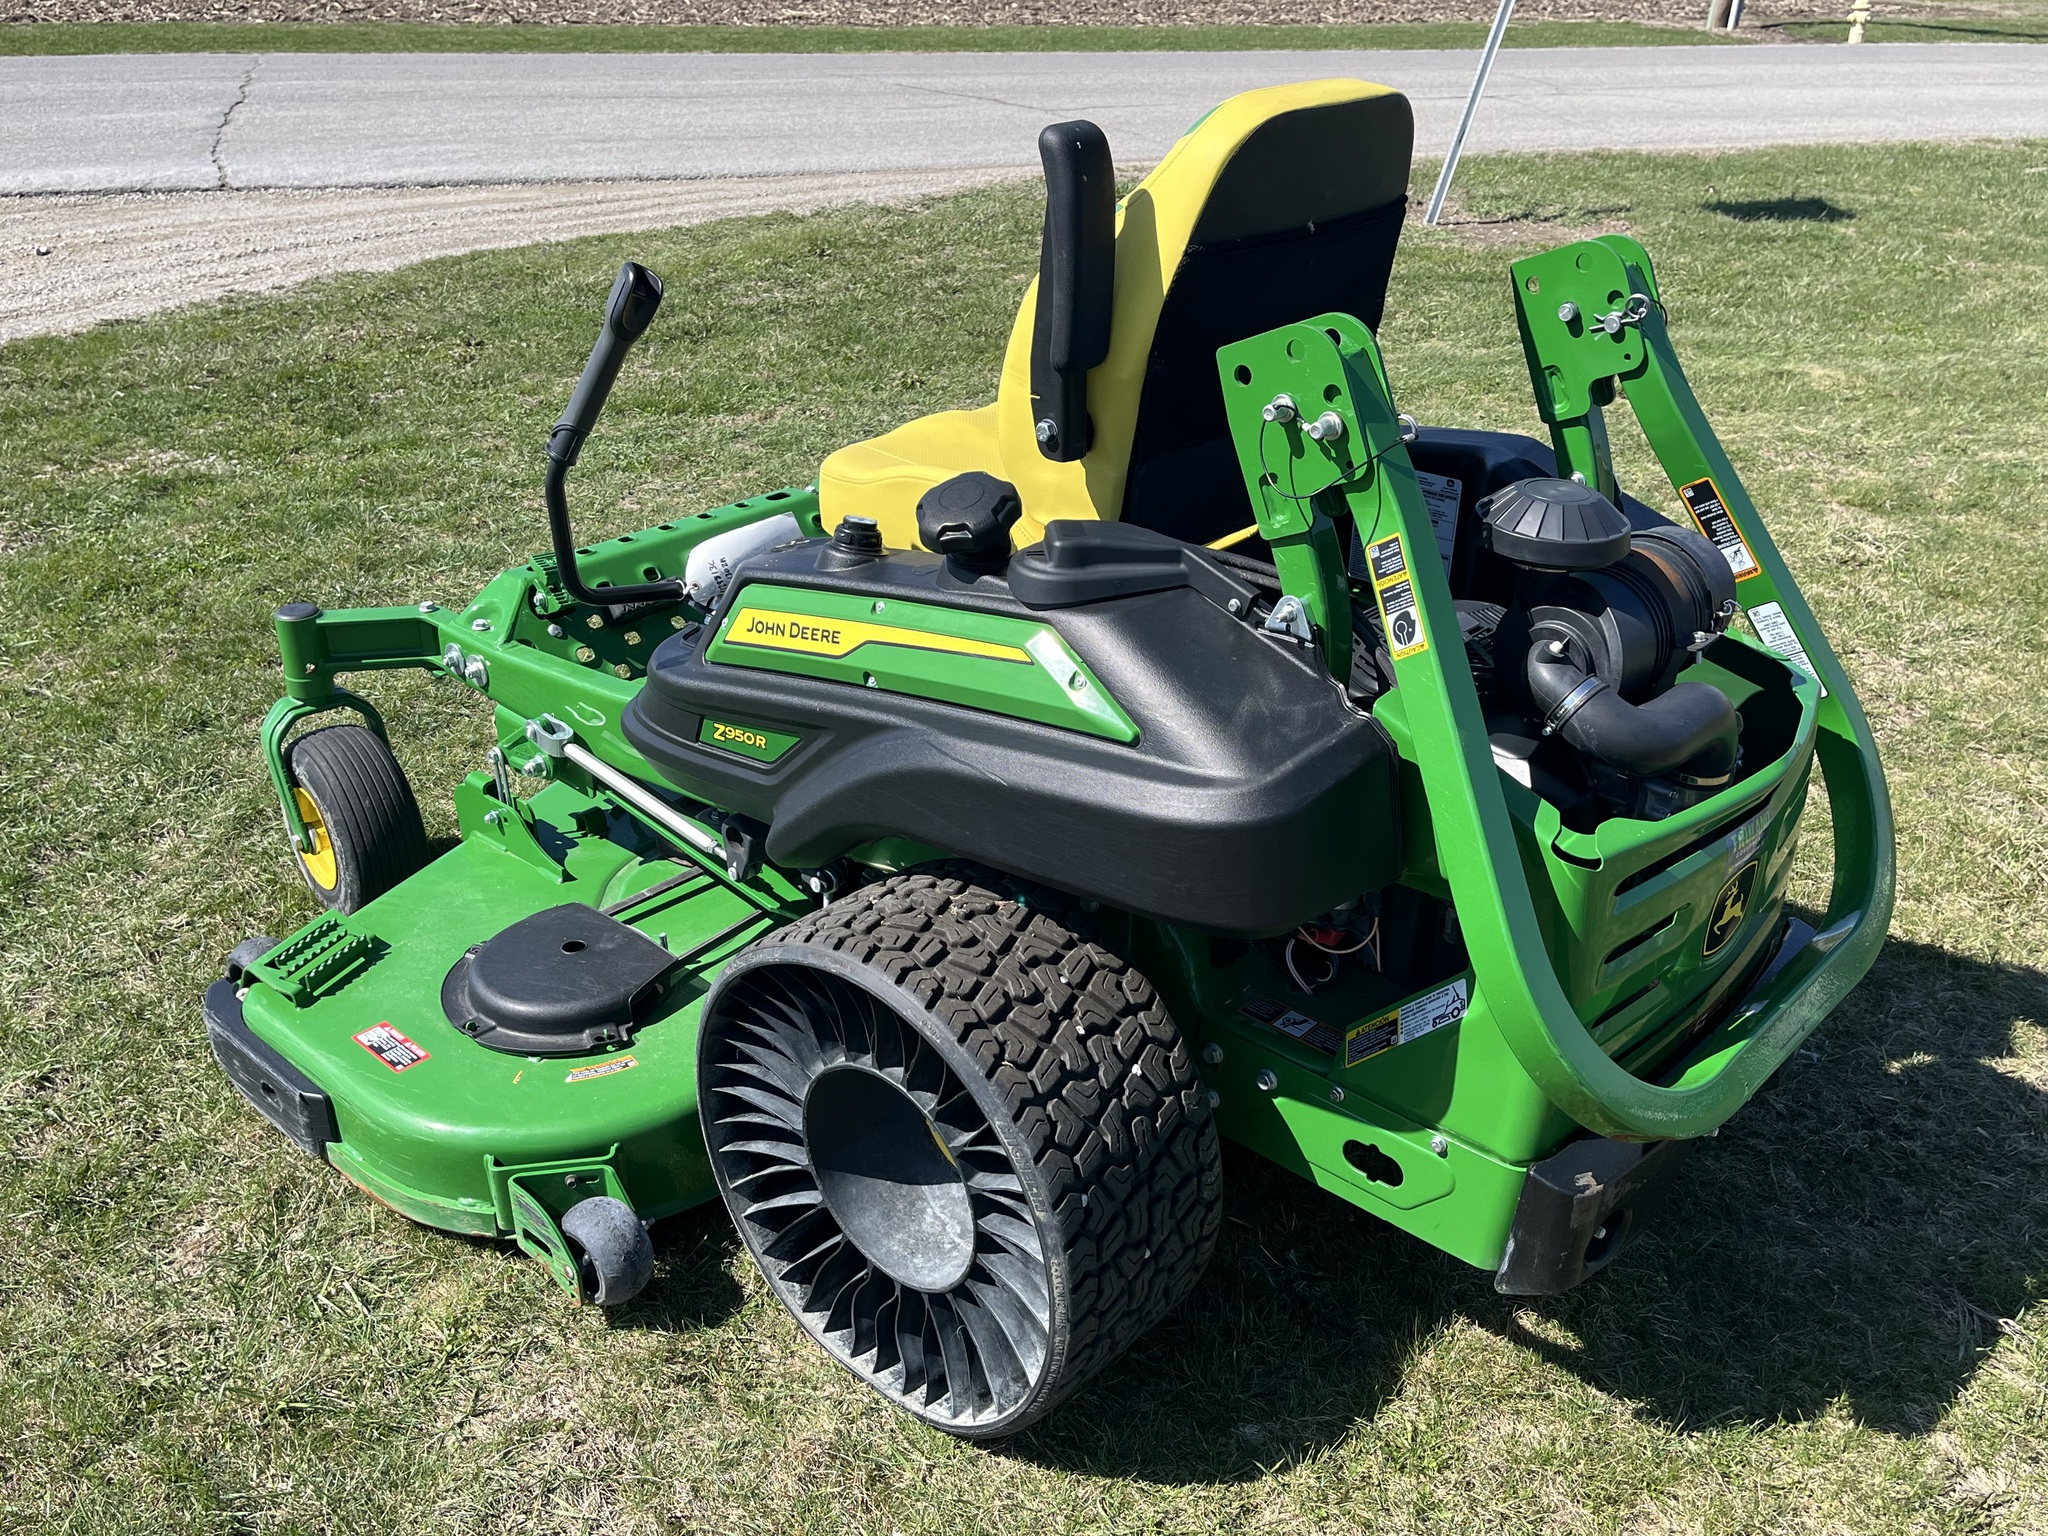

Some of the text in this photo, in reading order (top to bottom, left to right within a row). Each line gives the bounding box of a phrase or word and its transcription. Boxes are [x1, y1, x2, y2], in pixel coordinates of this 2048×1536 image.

[746, 616, 841, 644] JOHN DEERE
[713, 722, 768, 750] Z950R
[1360, 1015, 1390, 1035] ATENCIÓN
